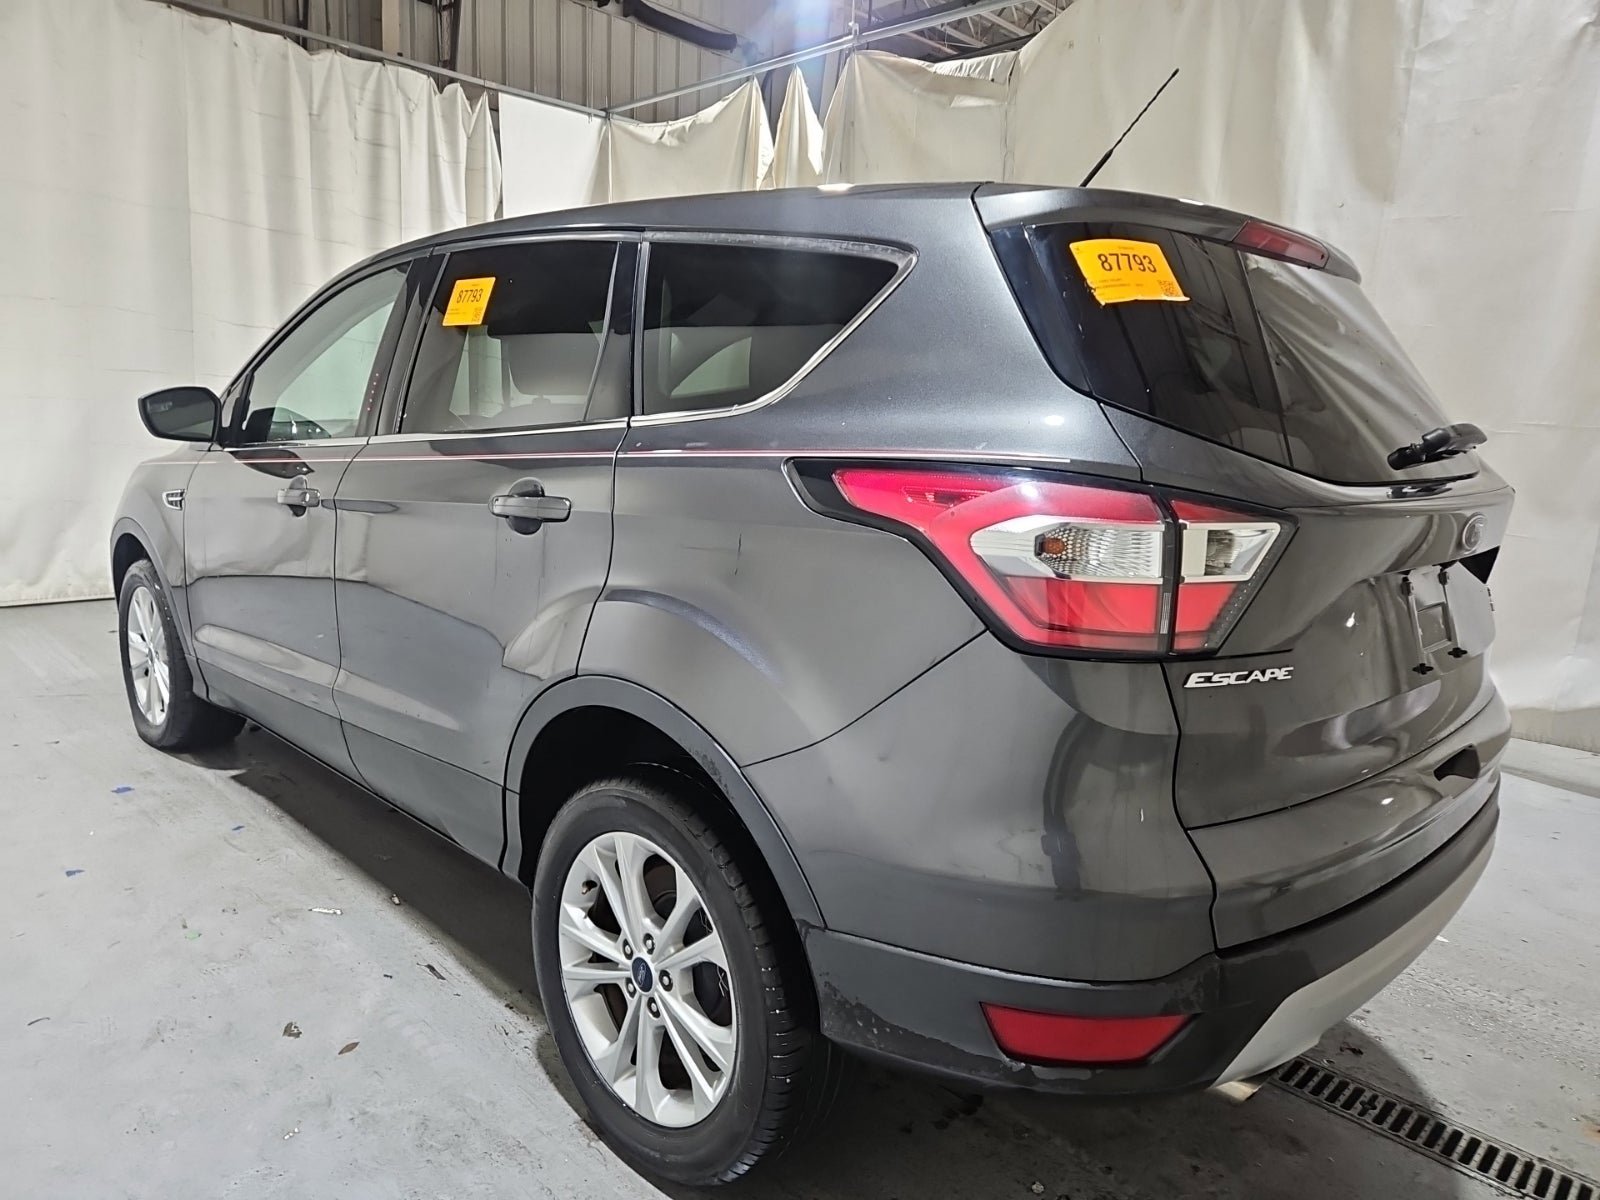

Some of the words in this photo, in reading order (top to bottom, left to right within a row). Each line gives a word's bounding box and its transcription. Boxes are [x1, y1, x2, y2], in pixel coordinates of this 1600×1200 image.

[1097, 253, 1157, 273] 87793
[456, 288, 484, 304] 87793
[1183, 666, 1294, 688] ESCAPE
